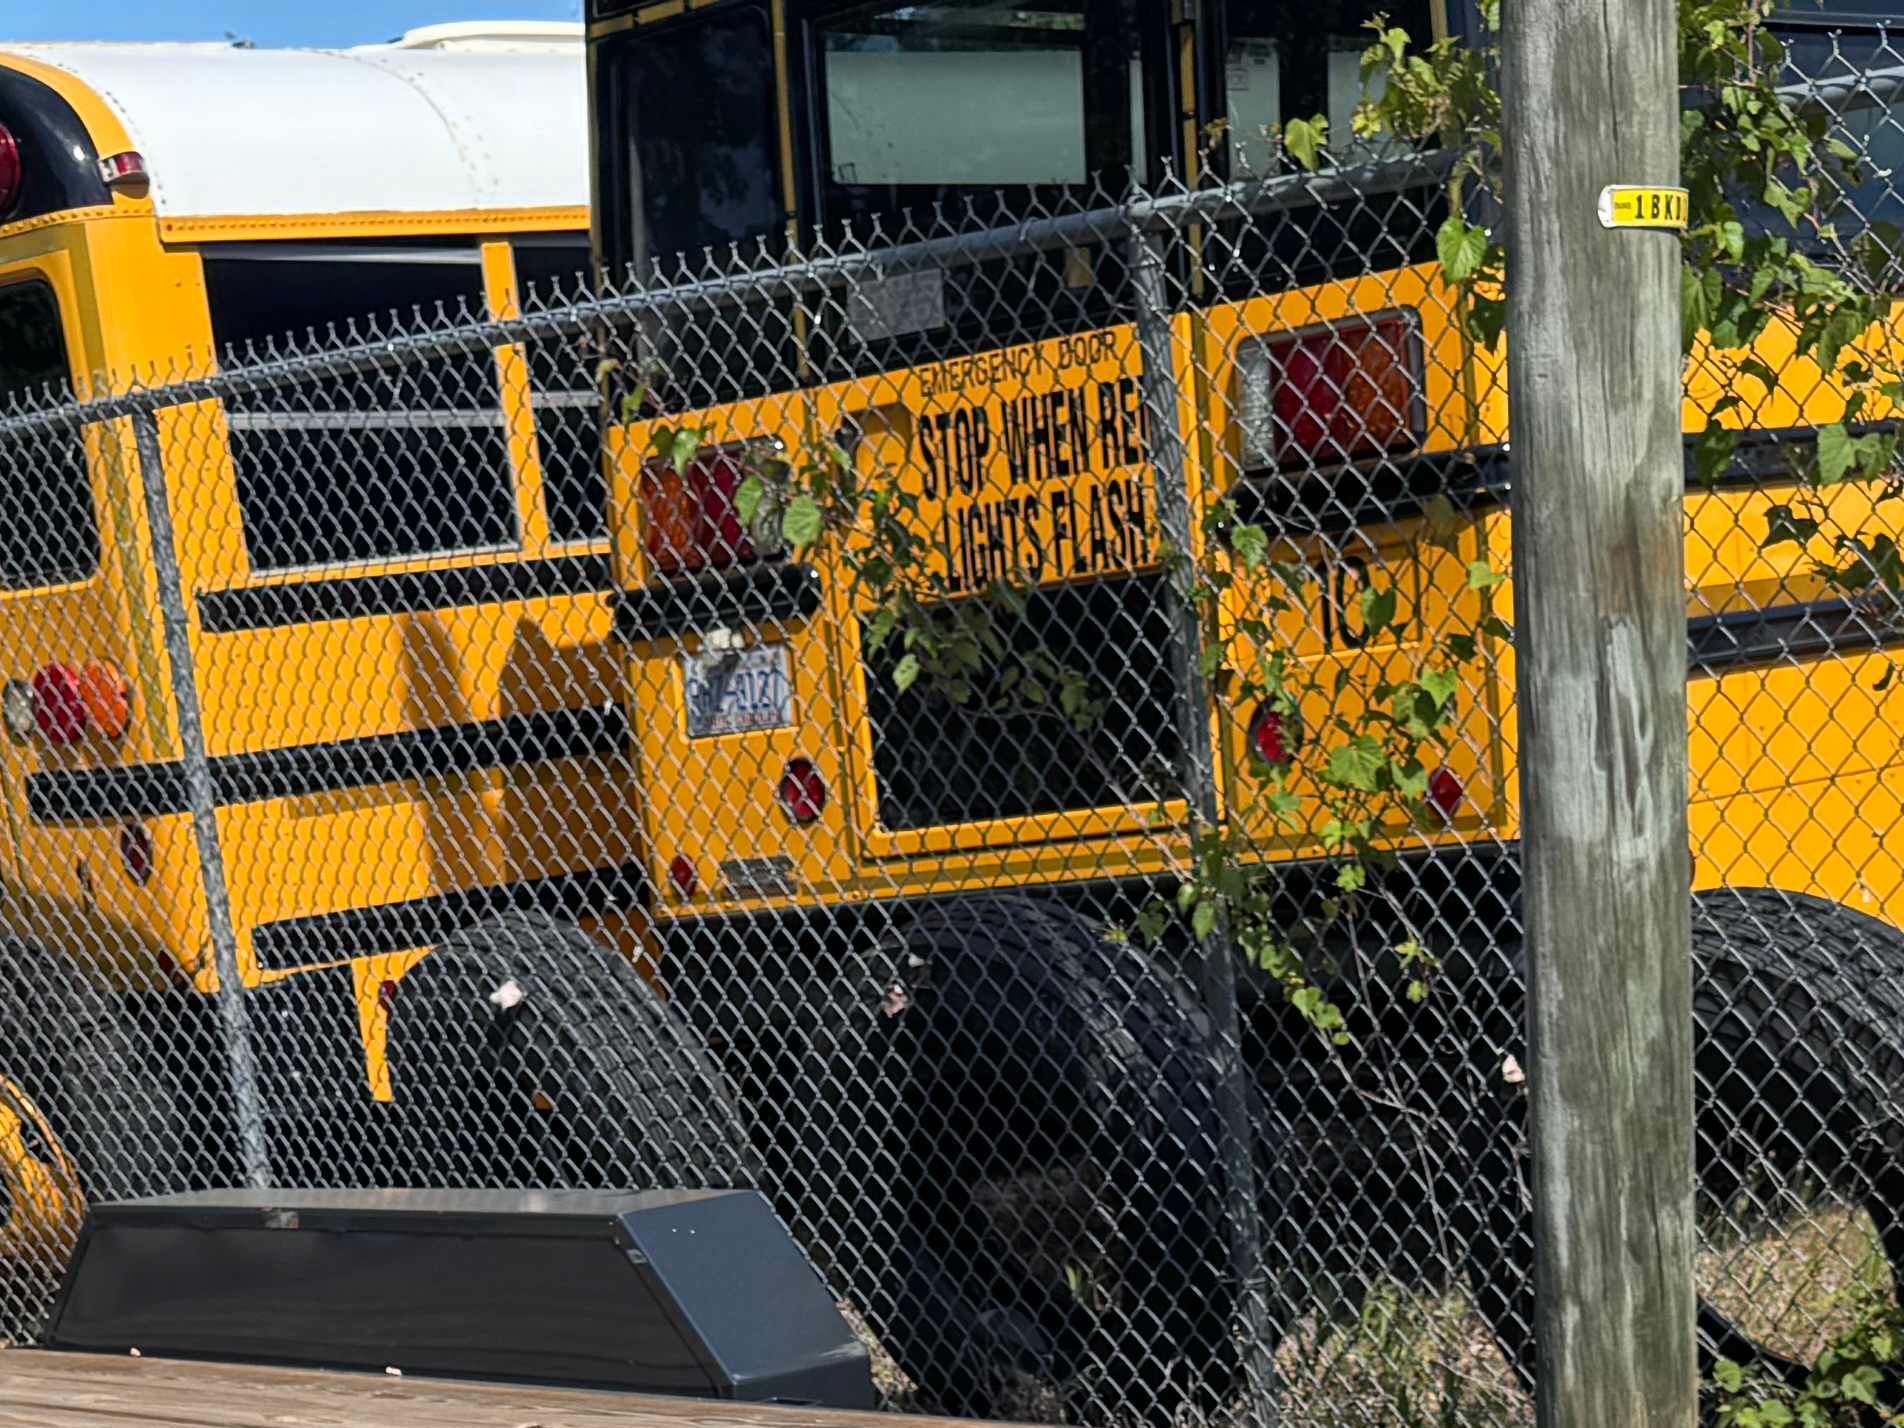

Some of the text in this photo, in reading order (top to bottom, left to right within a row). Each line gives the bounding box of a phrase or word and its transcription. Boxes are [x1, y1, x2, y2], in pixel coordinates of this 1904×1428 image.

[919, 330, 1120, 398] EMERGENCY DOOR
[919, 405, 989, 501] STOP
[1001, 384, 1089, 485] WHEN
[946, 478, 1147, 593] LIGHTS FLASH
